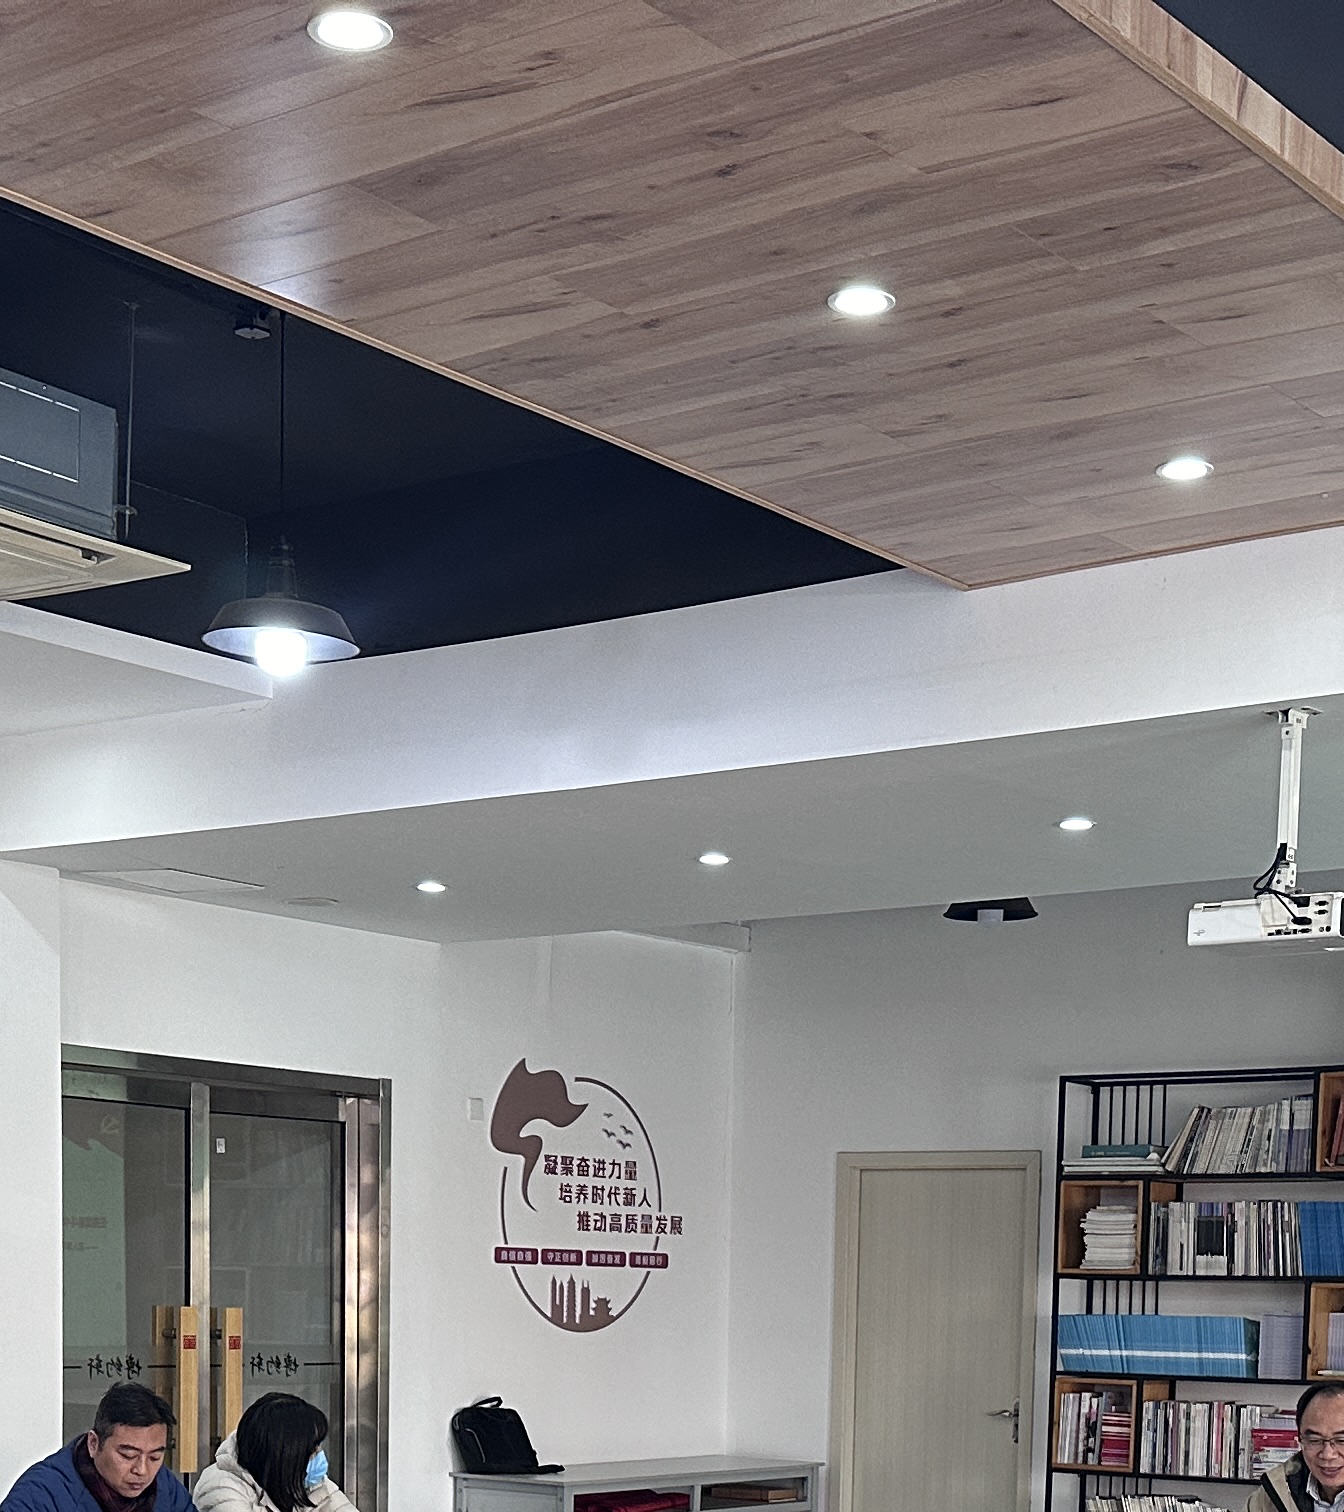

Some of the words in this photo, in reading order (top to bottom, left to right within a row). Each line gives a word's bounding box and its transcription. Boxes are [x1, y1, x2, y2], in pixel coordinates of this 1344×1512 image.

[543, 1154, 638, 1181] 凝聚奋进力量
[558, 1182, 652, 1208] 培养时代新人
[576, 1210, 683, 1236] 推动高质量发展
